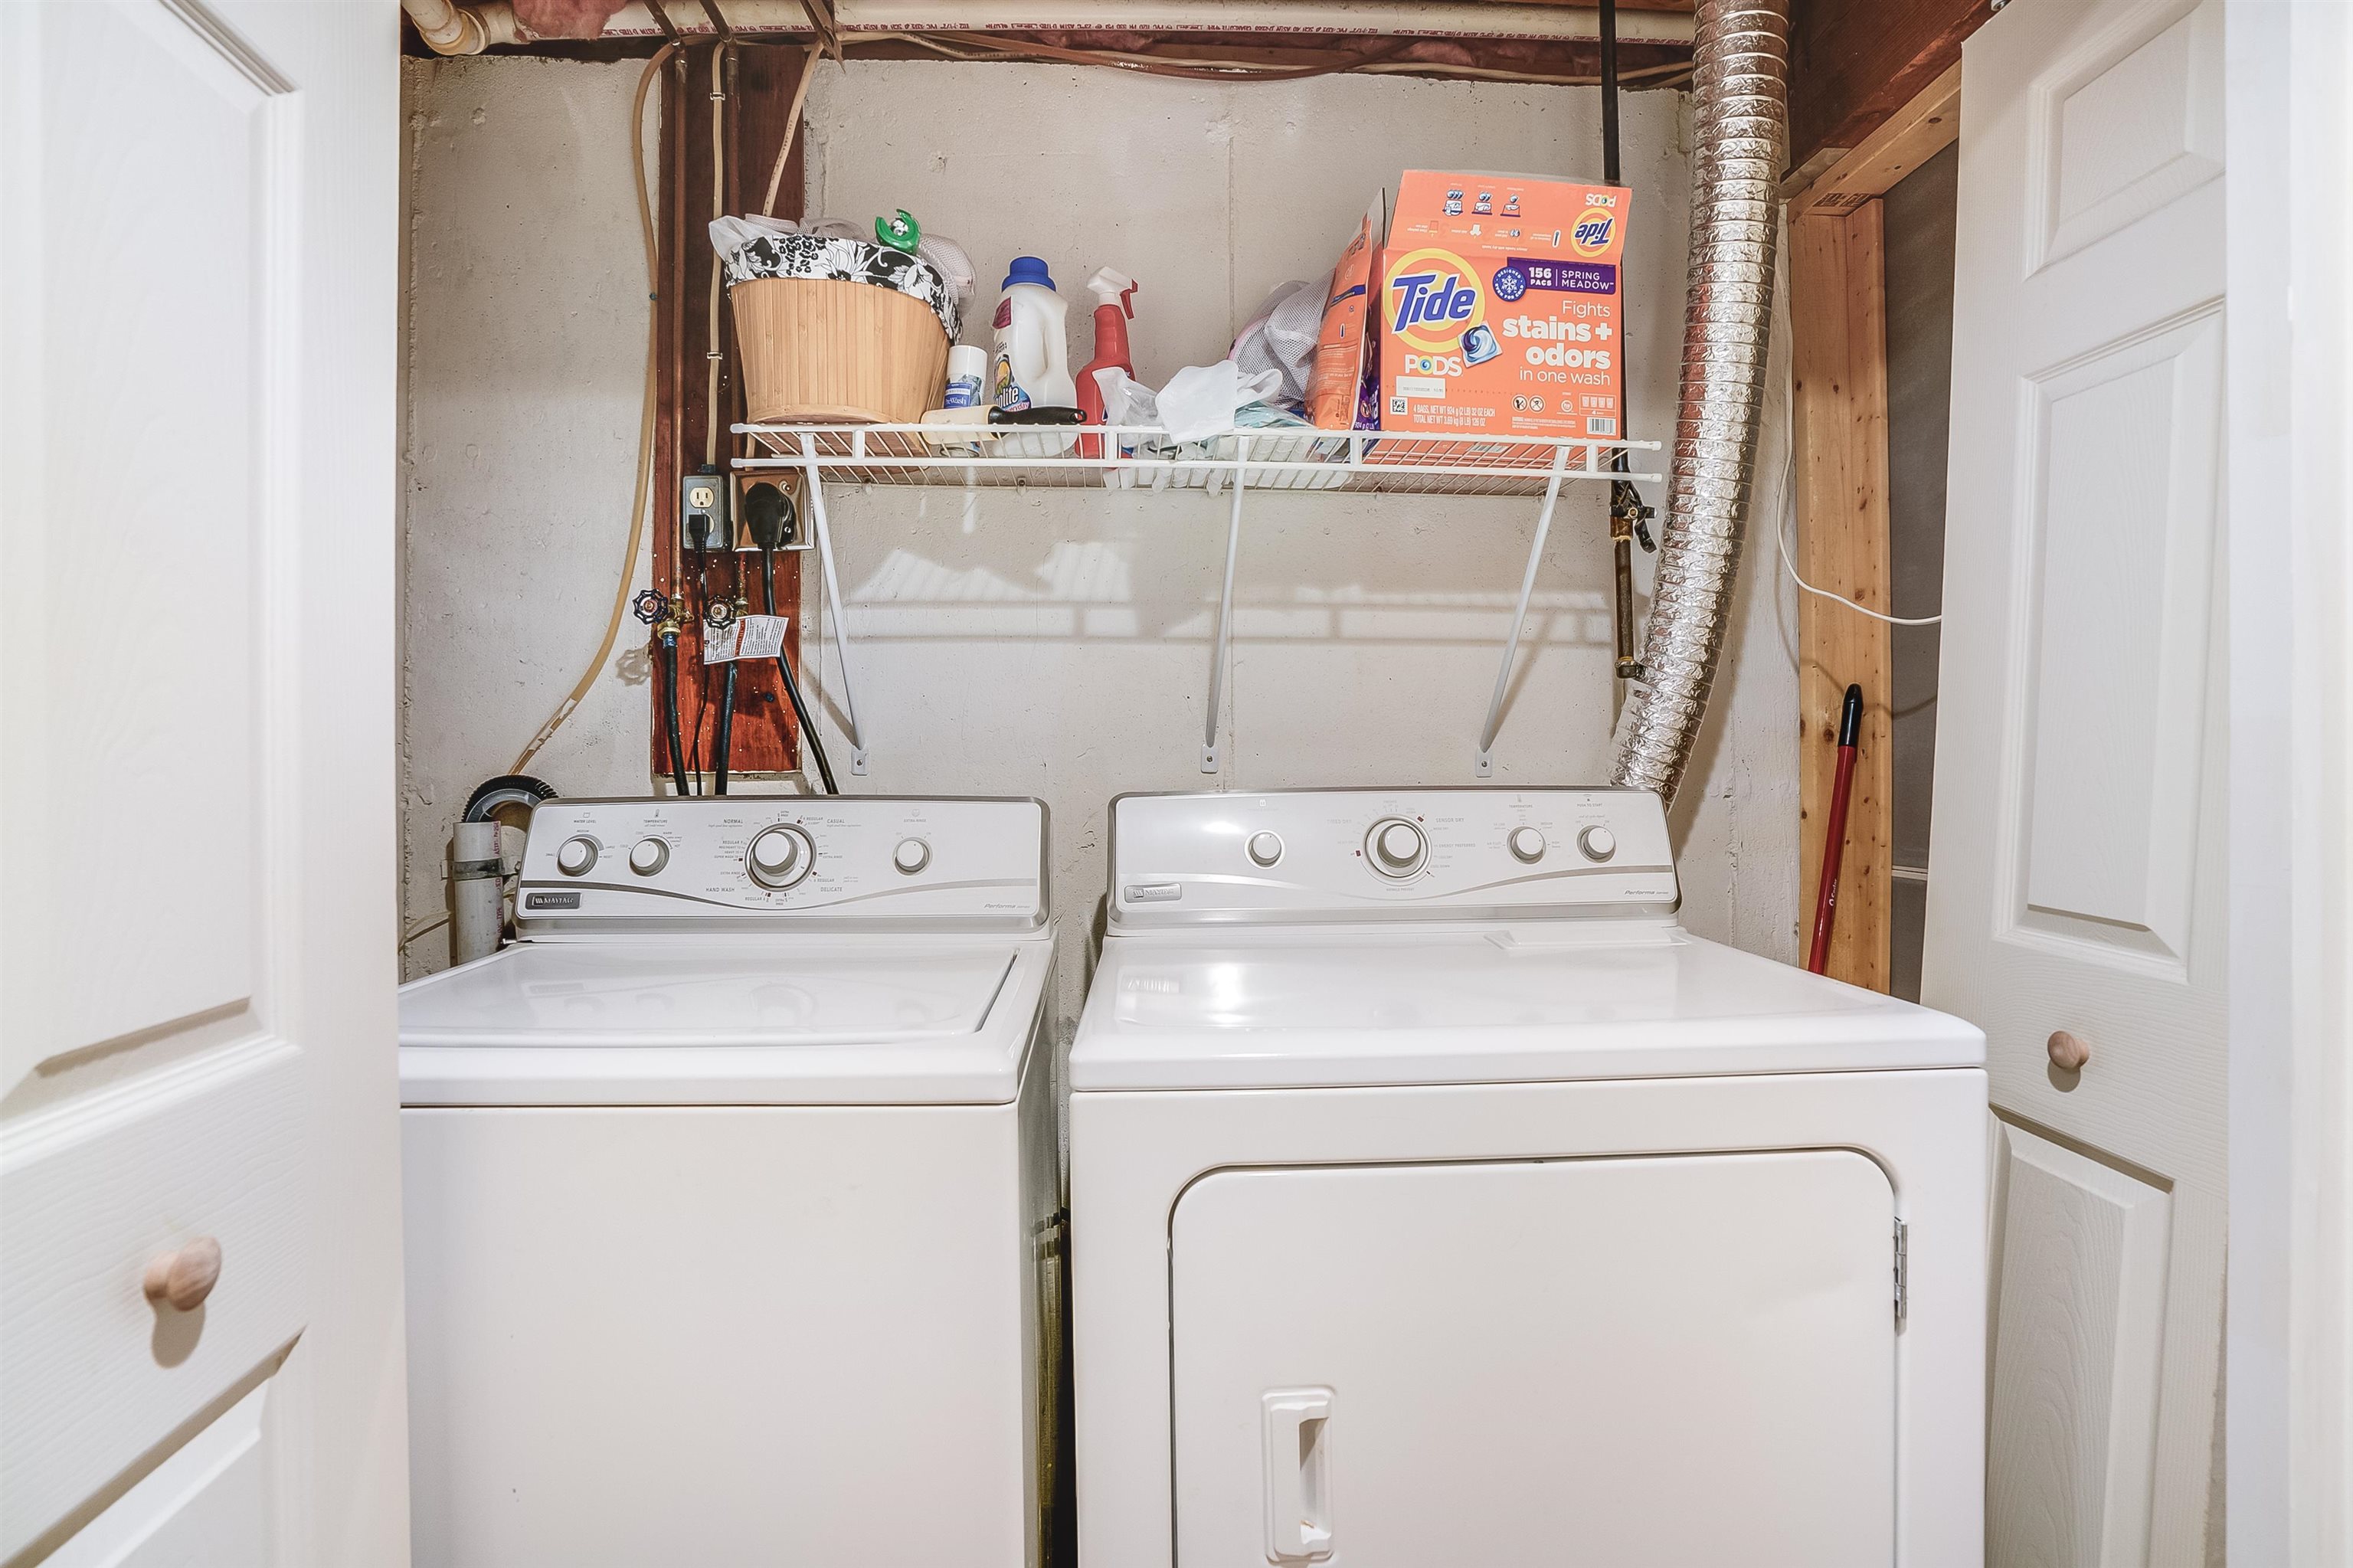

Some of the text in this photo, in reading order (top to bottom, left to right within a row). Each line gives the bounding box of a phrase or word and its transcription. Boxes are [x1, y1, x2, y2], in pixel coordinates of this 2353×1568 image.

[1585, 193, 1617, 208] PODS
[1574, 217, 1615, 247] Tide
[1529, 267, 1552, 279] 156
[1562, 270, 1600, 280] SPRING
[1391, 273, 1476, 335] Tide
[1562, 300, 1611, 319] Fights
[1501, 315, 1612, 342] stains +
[1404, 354, 1462, 377] PODS
[1525, 342, 1612, 370] odors
[1519, 366, 1611, 386] in one wash
[1413, 414, 1427, 423] TOTAL
[1427, 415, 1436, 424] NET
[1436, 416, 1444, 424] WT
[1430, 405, 1439, 414] NET
[1439, 406, 1447, 414] WT
[1471, 408, 1478, 416] 32
[1478, 408, 1484, 417] OZ
[1484, 408, 1495, 417] EACH
